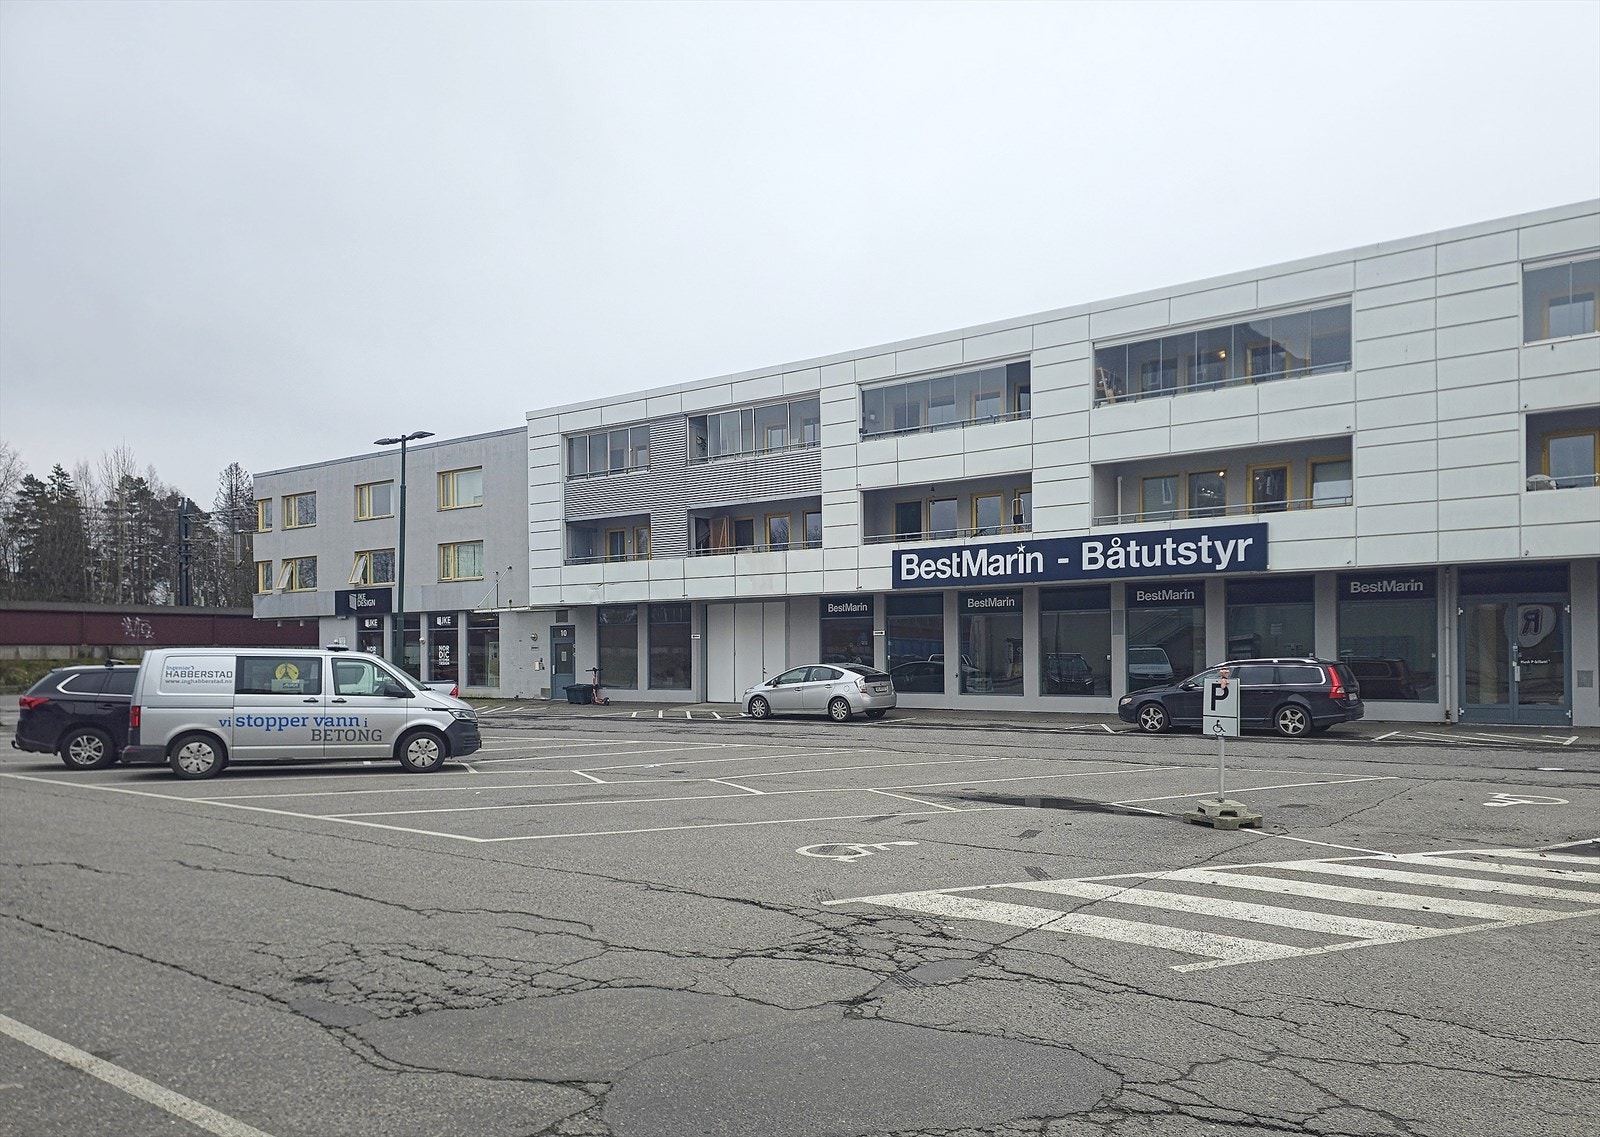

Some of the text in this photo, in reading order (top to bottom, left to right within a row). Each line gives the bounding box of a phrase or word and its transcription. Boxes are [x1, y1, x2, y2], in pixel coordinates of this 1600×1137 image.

[900, 543, 1044, 581] BestMarin
[1081, 535, 1253, 571] Båtutstyr
[1350, 579, 1424, 593] BestMarin
[1136, 589, 1195, 602] BestMarin
[357, 599, 376, 607] DESIGN
[827, 603, 868, 613] BestMarin
[967, 597, 1015, 608] BestMarin
[560, 629, 568, 637] 10
[165, 670, 233, 678] HABBERSTAD
[1211, 683, 1229, 711] P
[219, 714, 368, 731] vi stopper vann i
[311, 729, 382, 741] BETONG
